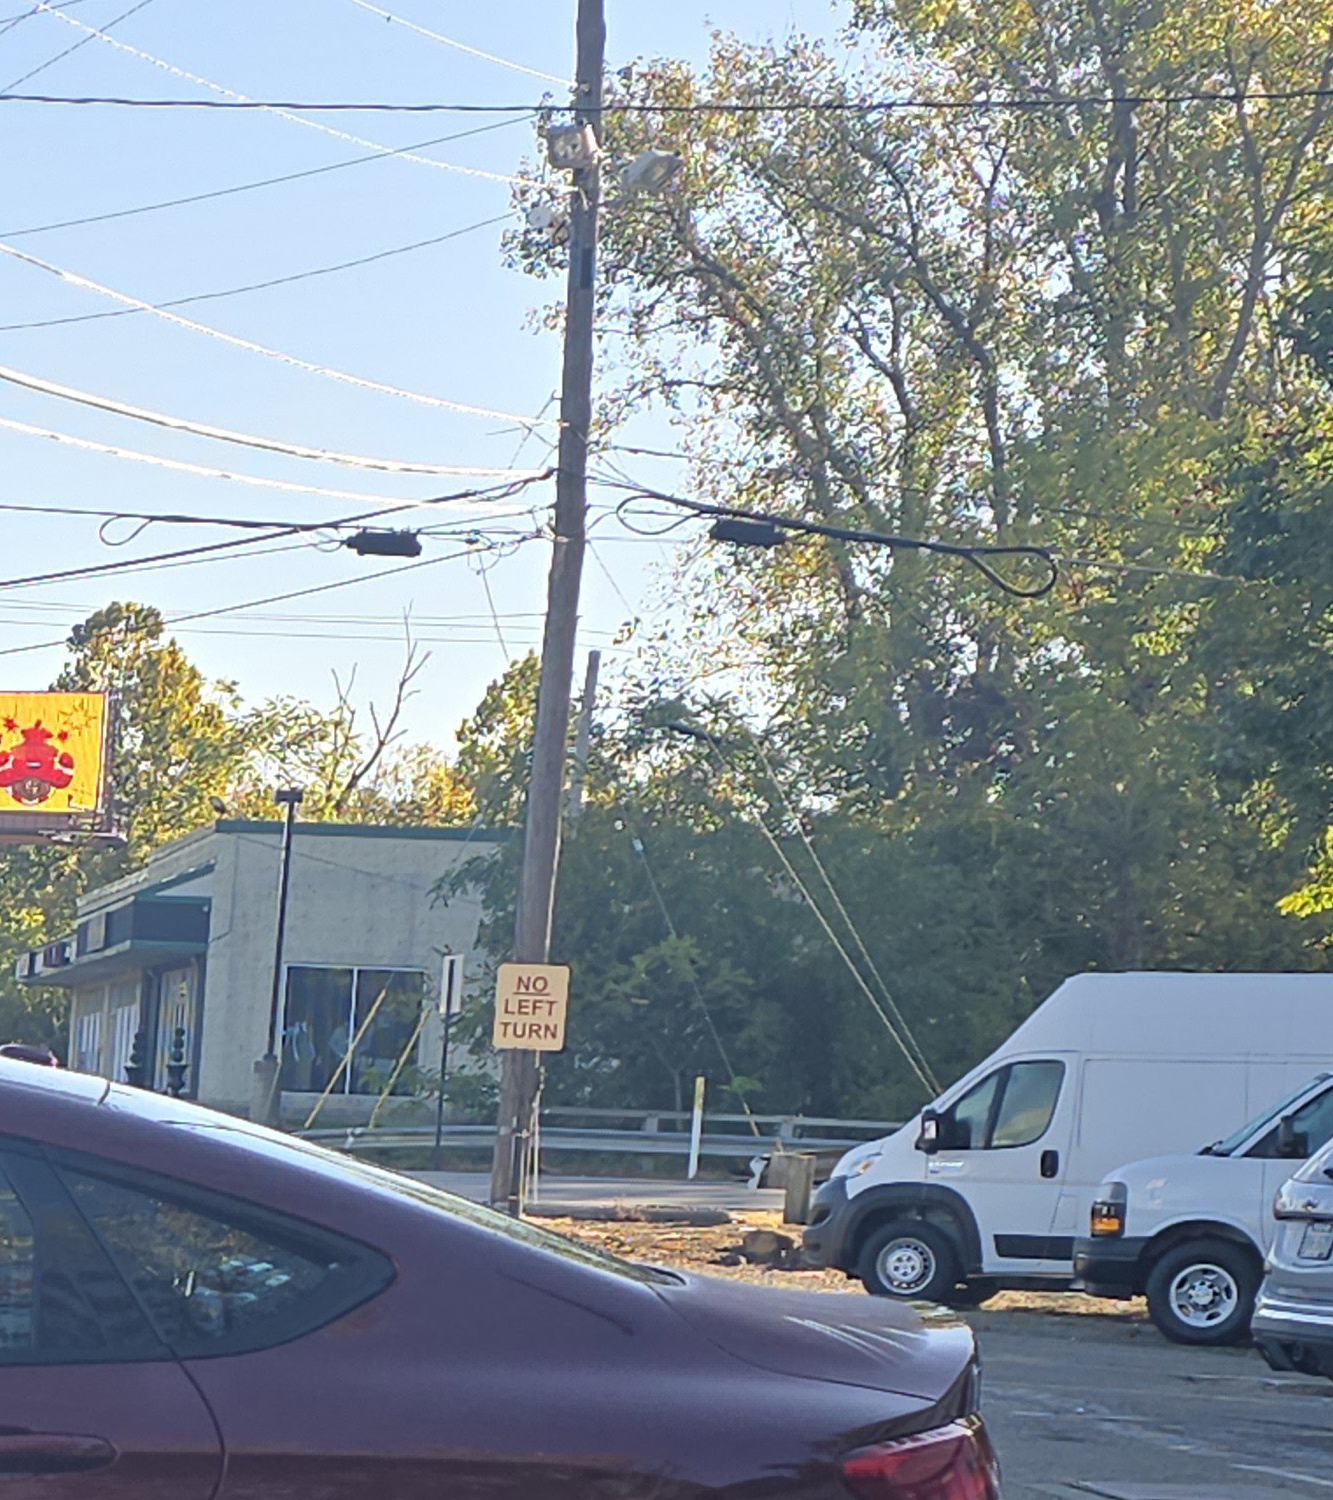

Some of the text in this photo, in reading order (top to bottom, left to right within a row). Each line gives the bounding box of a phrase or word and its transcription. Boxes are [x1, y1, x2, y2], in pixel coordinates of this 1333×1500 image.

[516, 975, 548, 993] NO
[504, 998, 559, 1017] LEFT
[499, 1021, 559, 1040] TURN
